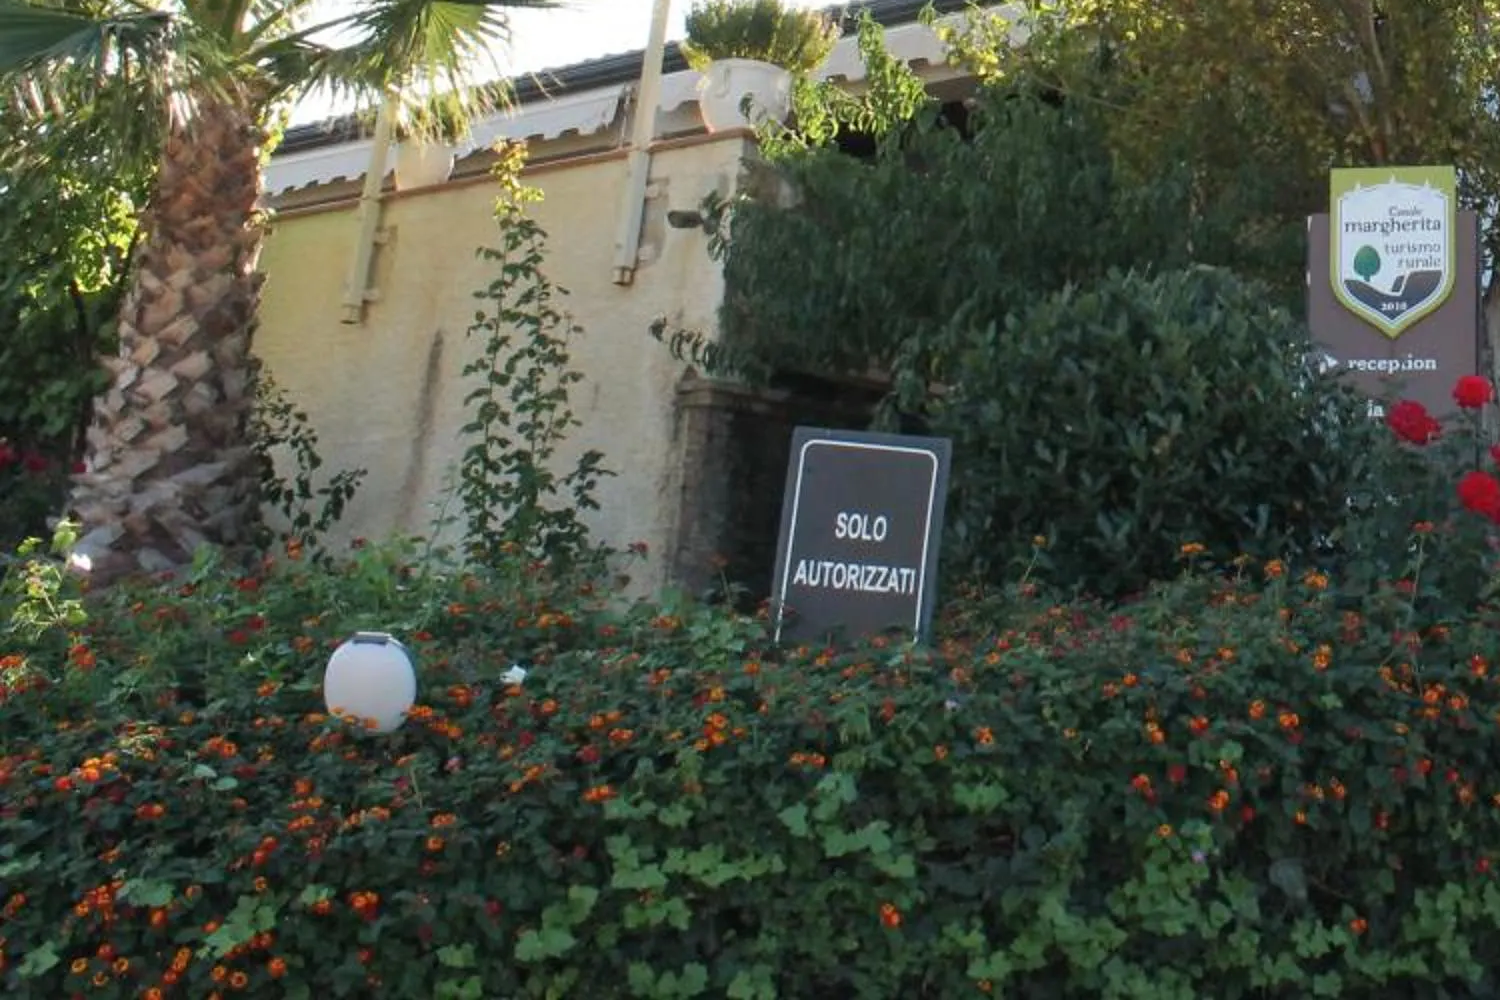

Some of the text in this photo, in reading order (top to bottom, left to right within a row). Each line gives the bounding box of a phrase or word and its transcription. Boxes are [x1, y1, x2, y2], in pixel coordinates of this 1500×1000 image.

[1343, 217, 1442, 236] margherita
[1384, 243, 1442, 255] turismo
[1398, 256, 1442, 269] rurale
[834, 512, 888, 541] SOLO
[793, 559, 917, 595] AUTORIZZATI
